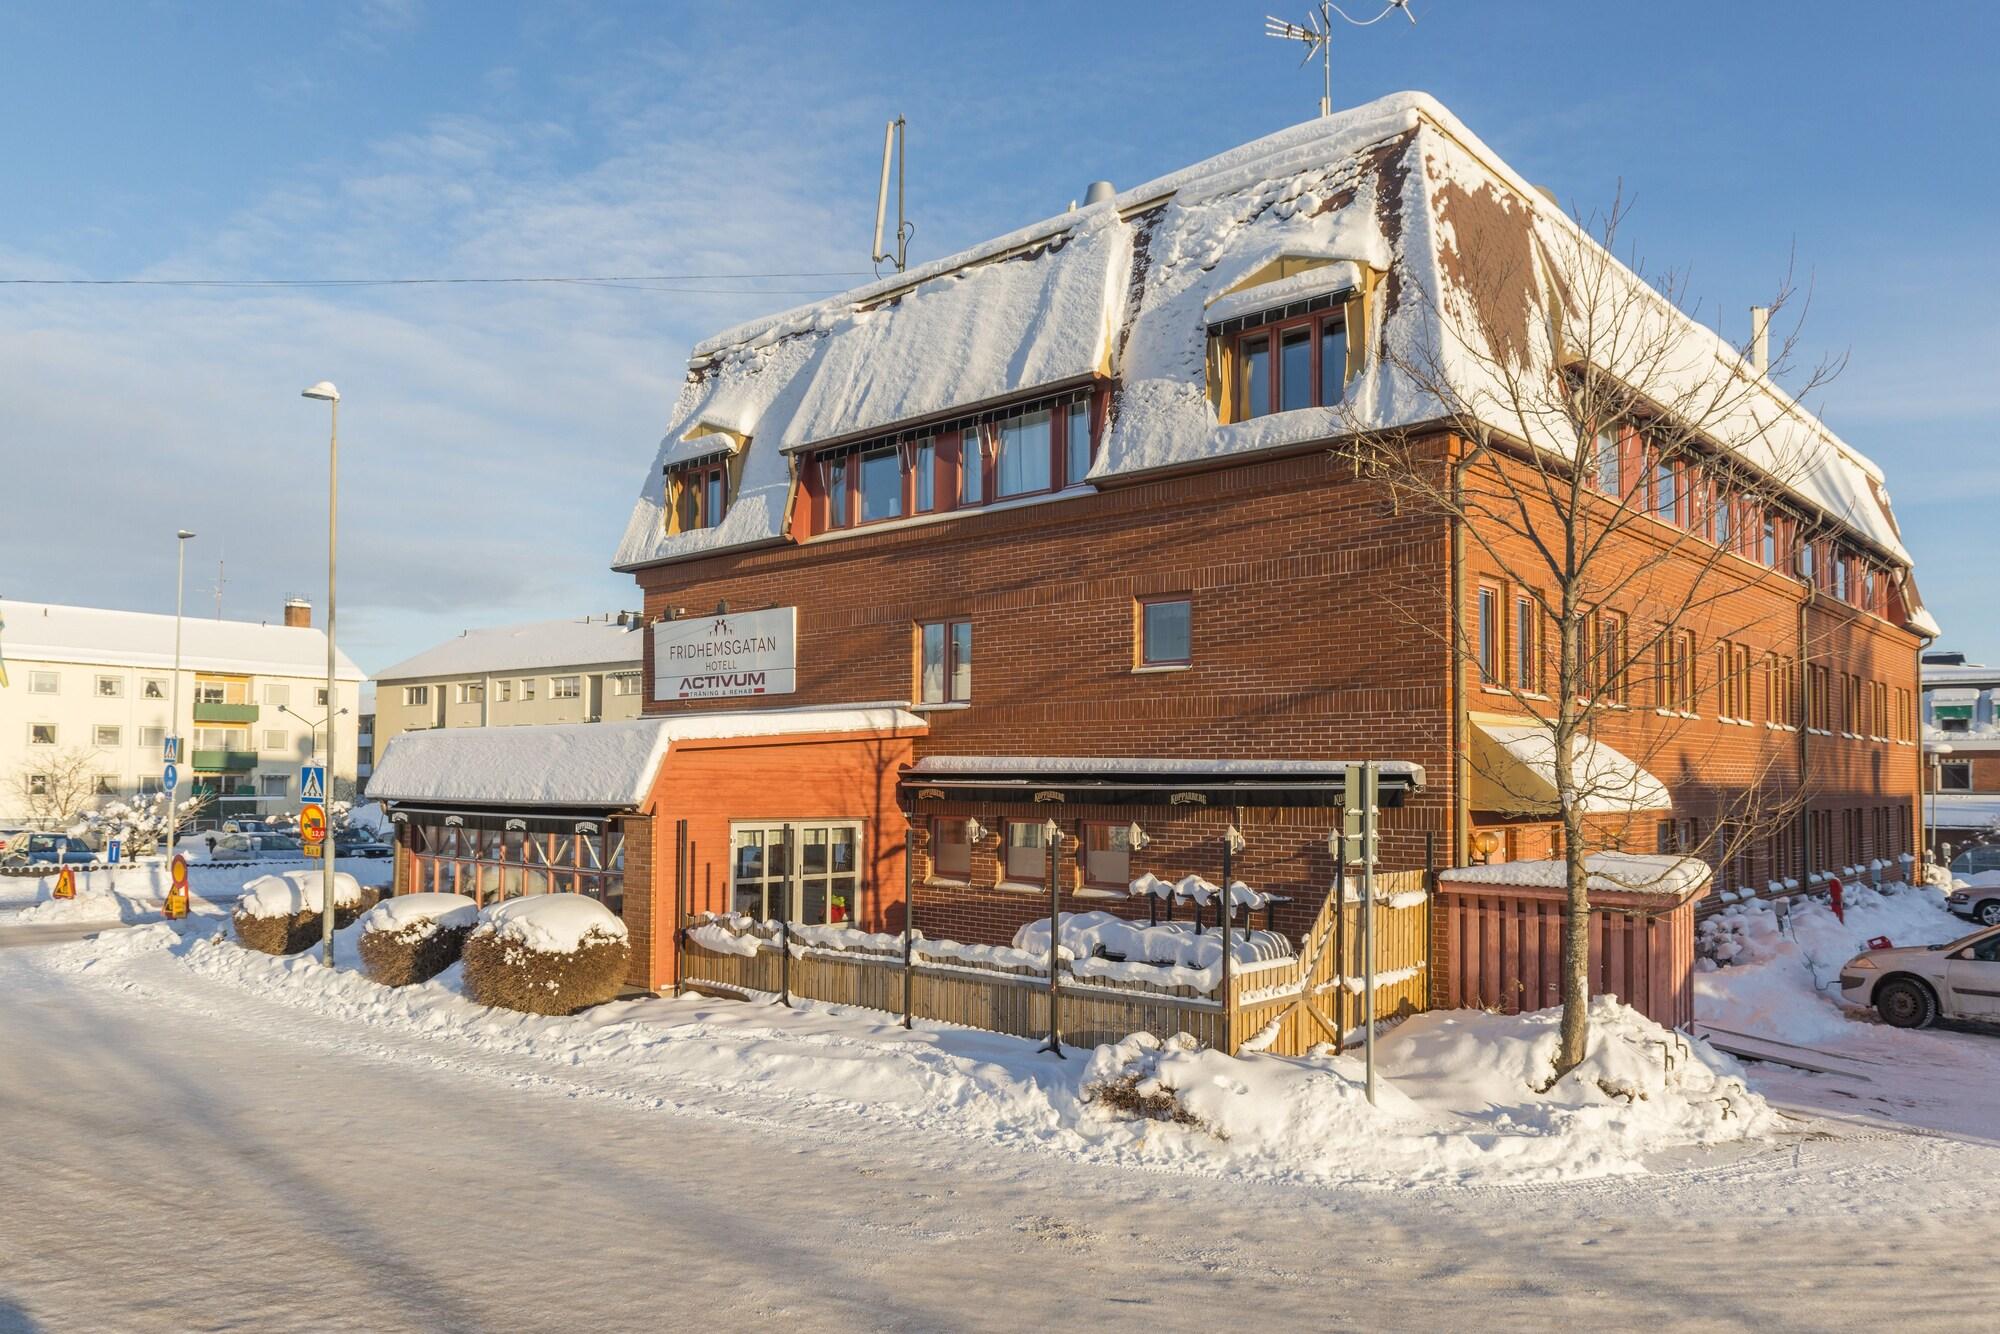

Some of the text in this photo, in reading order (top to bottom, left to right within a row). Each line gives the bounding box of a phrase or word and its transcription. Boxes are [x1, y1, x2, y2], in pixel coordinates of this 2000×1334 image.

[669, 636, 776, 660] FRIDHEMSGATAN
[705, 660, 737, 671] HOTELL
[679, 672, 766, 690] ACTIVUM
[1170, 792, 1207, 805] KOPPARBERG
